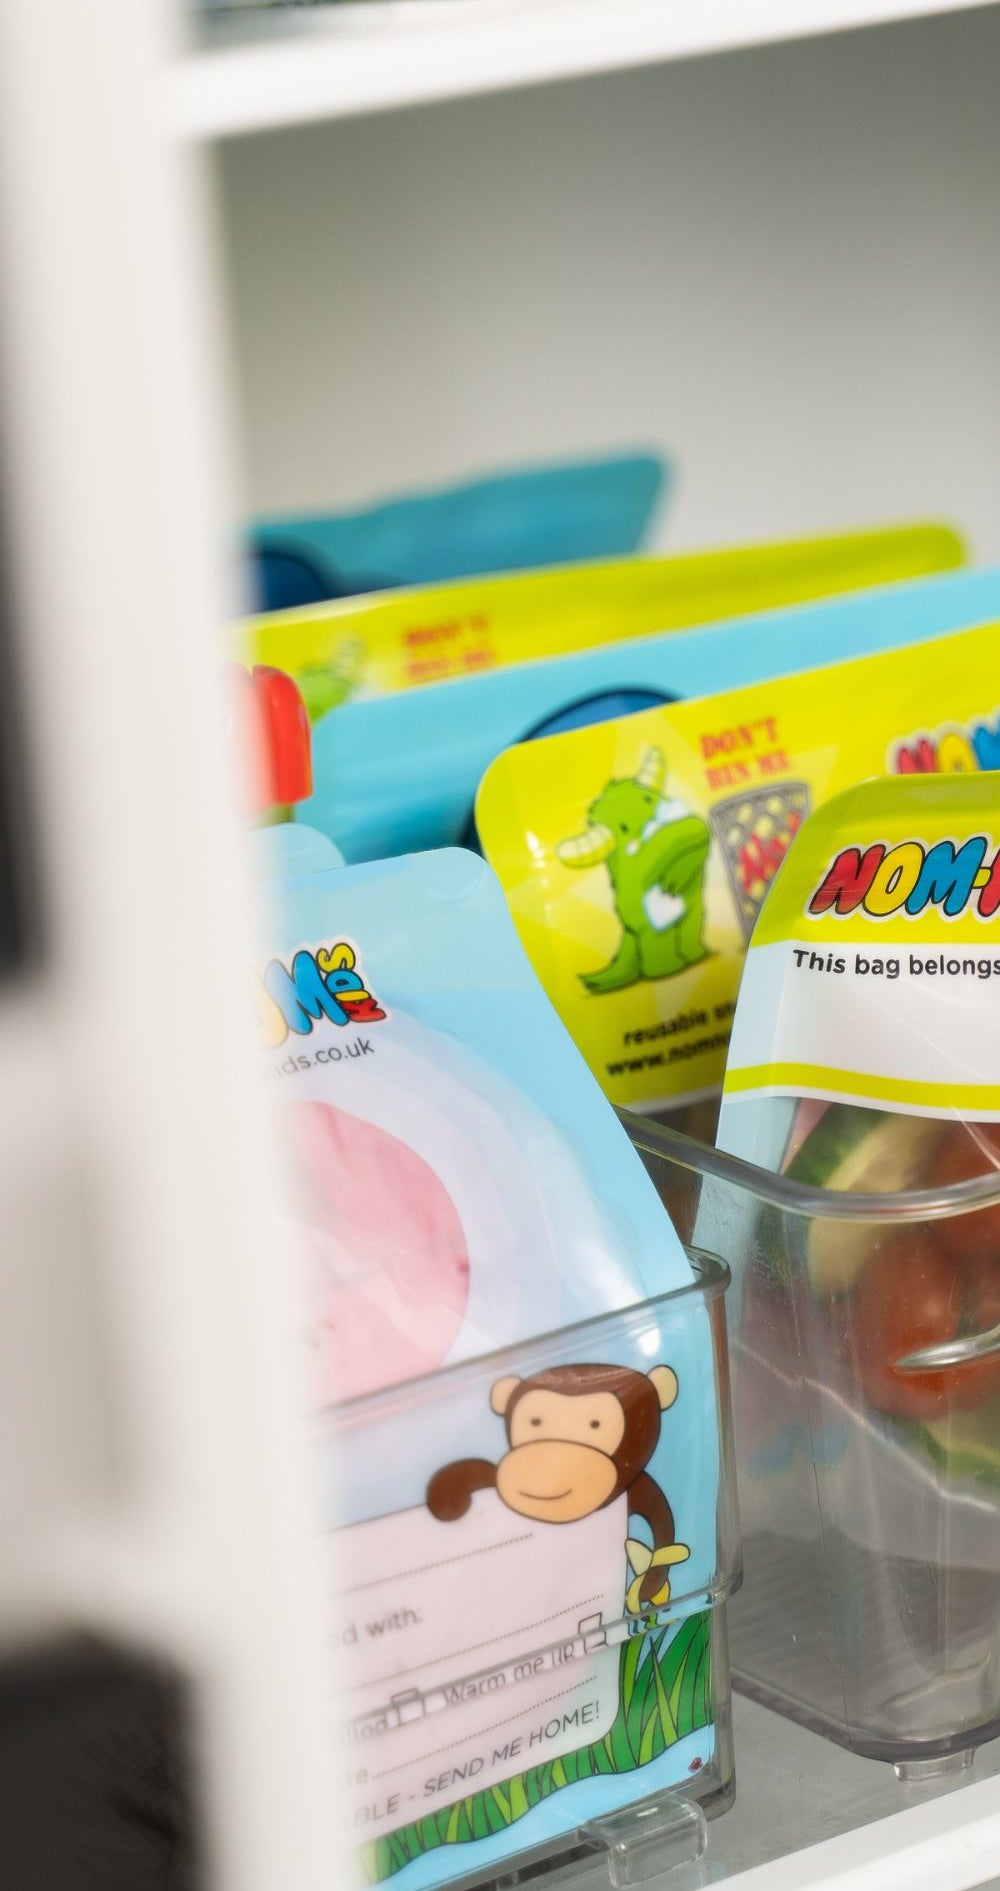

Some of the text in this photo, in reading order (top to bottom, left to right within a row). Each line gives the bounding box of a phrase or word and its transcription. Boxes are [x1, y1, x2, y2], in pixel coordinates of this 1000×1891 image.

[793, 949, 846, 974] This
[854, 953, 901, 979] bag
[366, 1607, 424, 1638] with:
[423, 1756, 485, 1799] SEND
[491, 1735, 523, 1769] ME
[528, 1699, 602, 1750] HOME!
